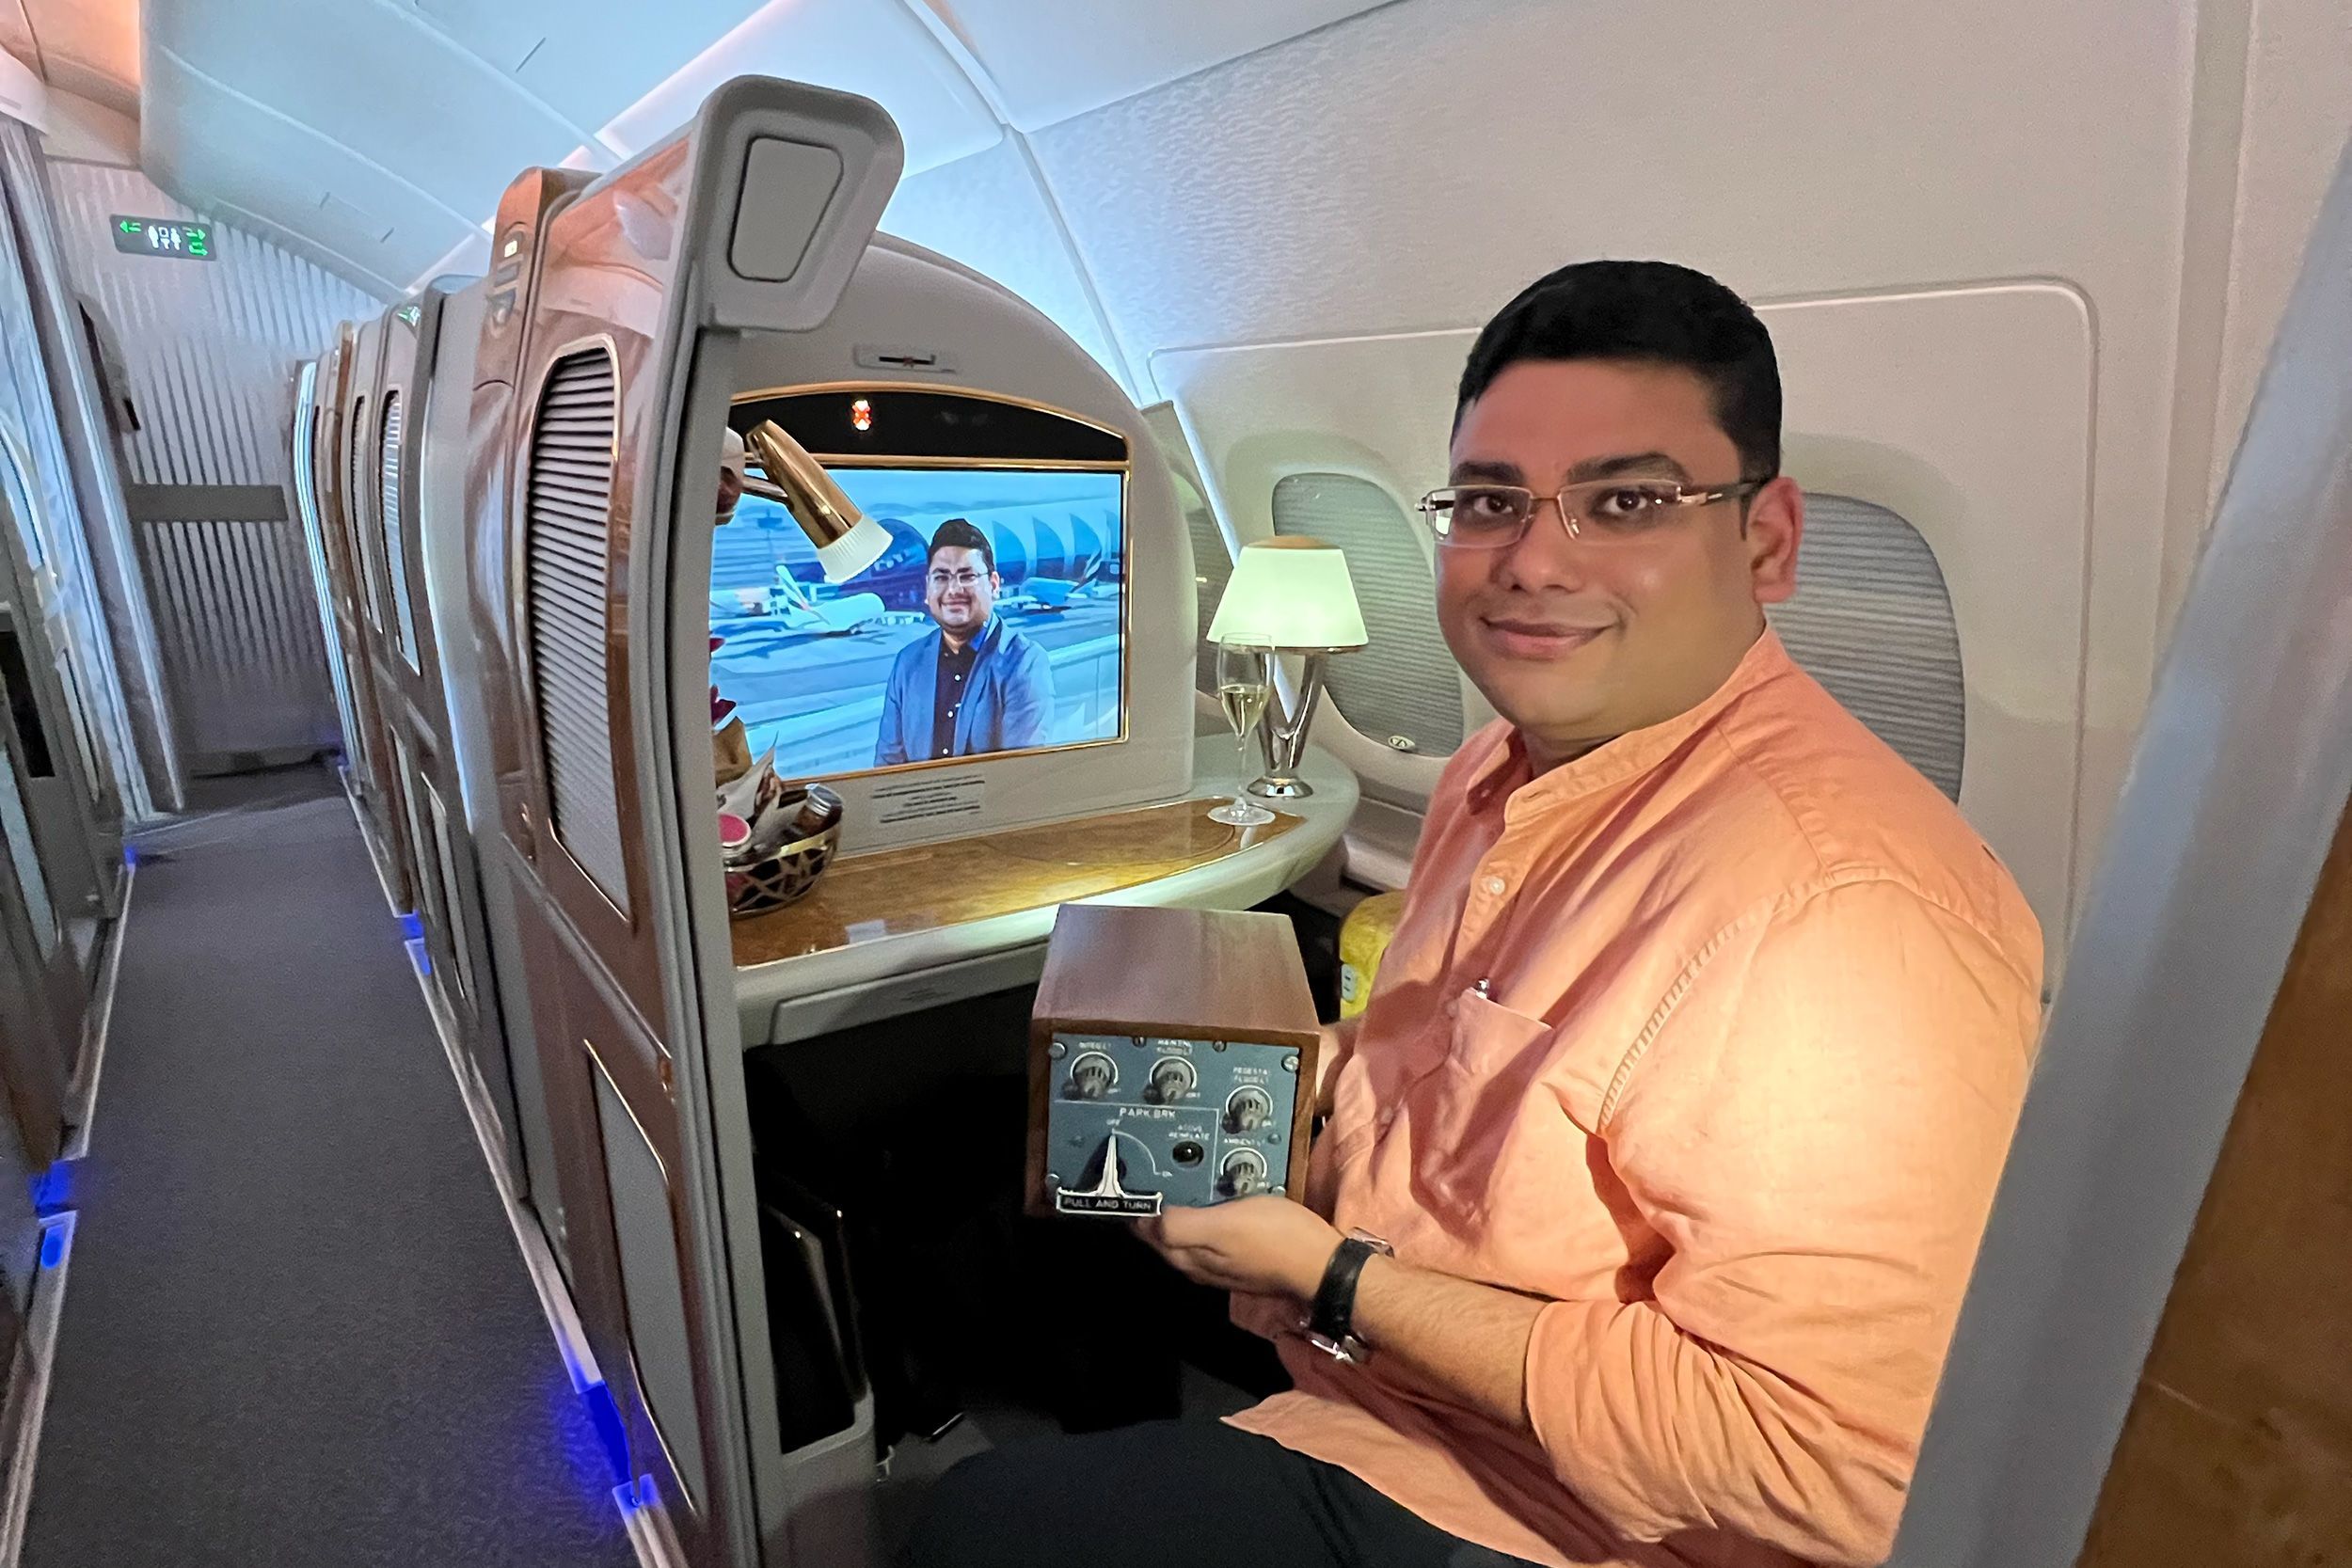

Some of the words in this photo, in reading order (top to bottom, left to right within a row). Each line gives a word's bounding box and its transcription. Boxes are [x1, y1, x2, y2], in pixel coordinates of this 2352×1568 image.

[1119, 1107, 1151, 1117] PARK
[1153, 1108, 1176, 1118] BRK
[1063, 1196, 1091, 1209] PULL
[1095, 1198, 1120, 1210] AND
[1123, 1200, 1152, 1211] TURN
